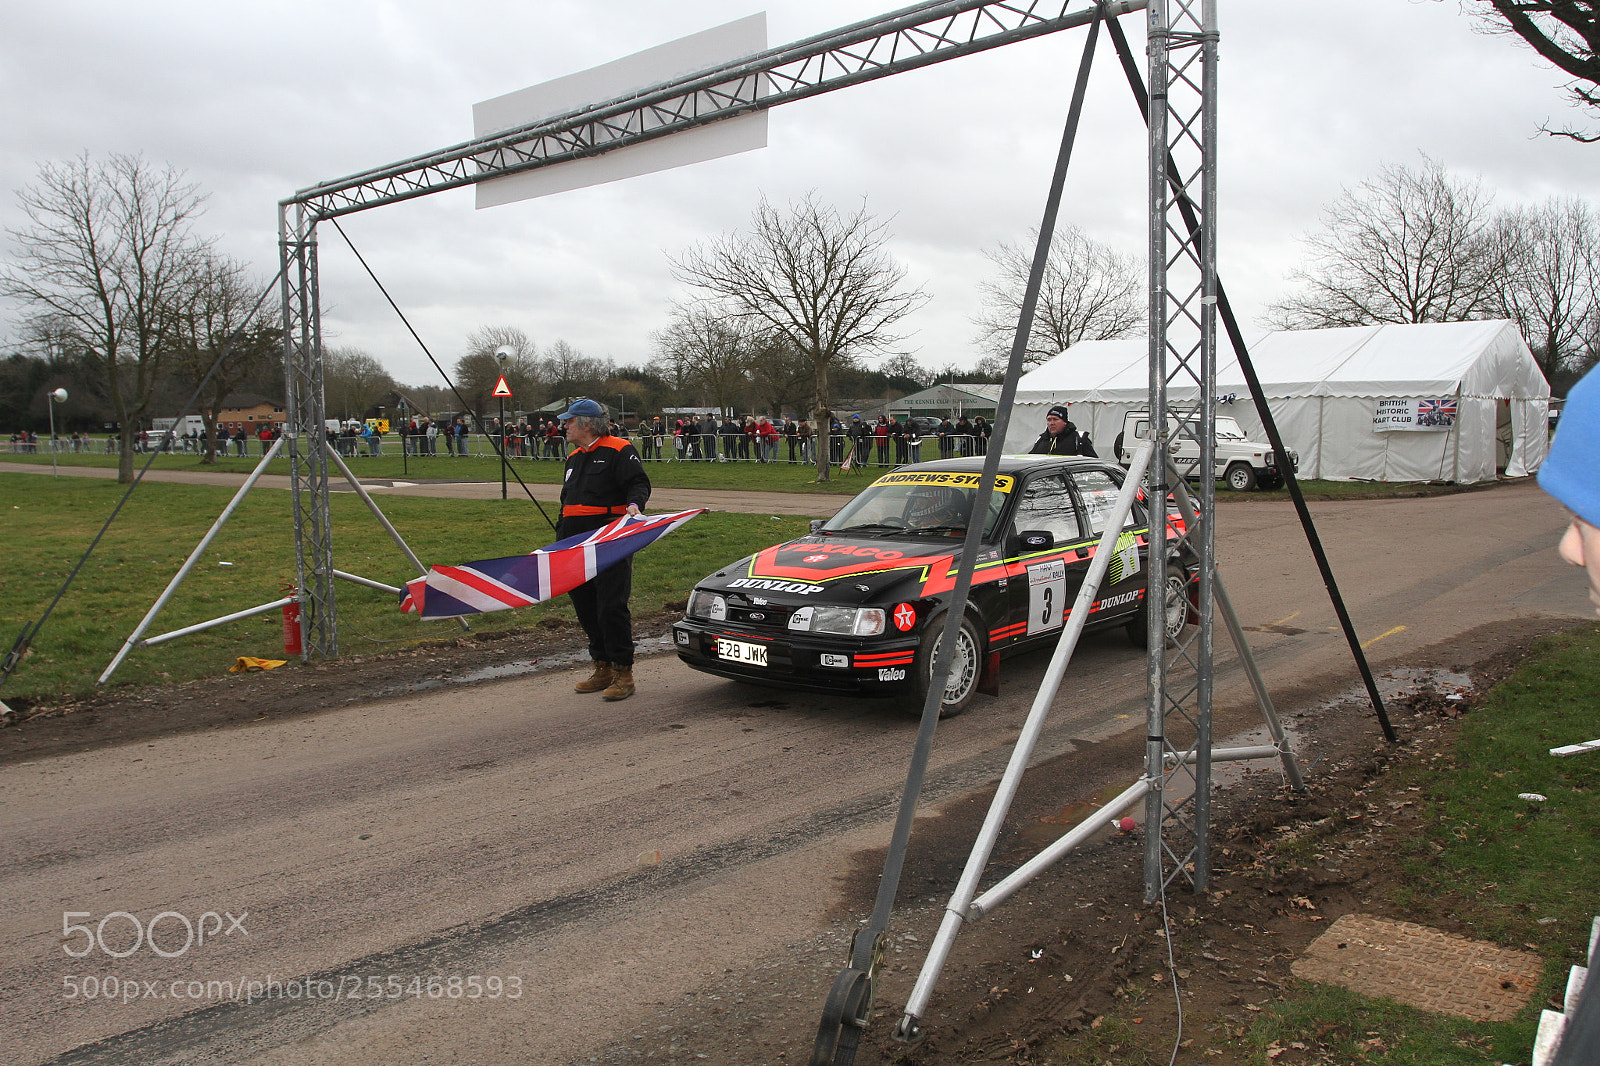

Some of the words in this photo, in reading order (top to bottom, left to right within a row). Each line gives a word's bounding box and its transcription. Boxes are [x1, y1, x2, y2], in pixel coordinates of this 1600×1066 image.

[1372, 416, 1390, 424] KART
[876, 474, 1008, 488] ANDREWS-SYKS
[779, 544, 904, 560] TEXACO
[1052, 570, 1064, 579] RALLY
[726, 578, 825, 595] DUNLOP
[1042, 587, 1053, 625] 3
[1100, 589, 1140, 611] DUNLOP
[718, 641, 740, 658] E28
[744, 646, 768, 664] JWK
[878, 668, 906, 682] Valeo
